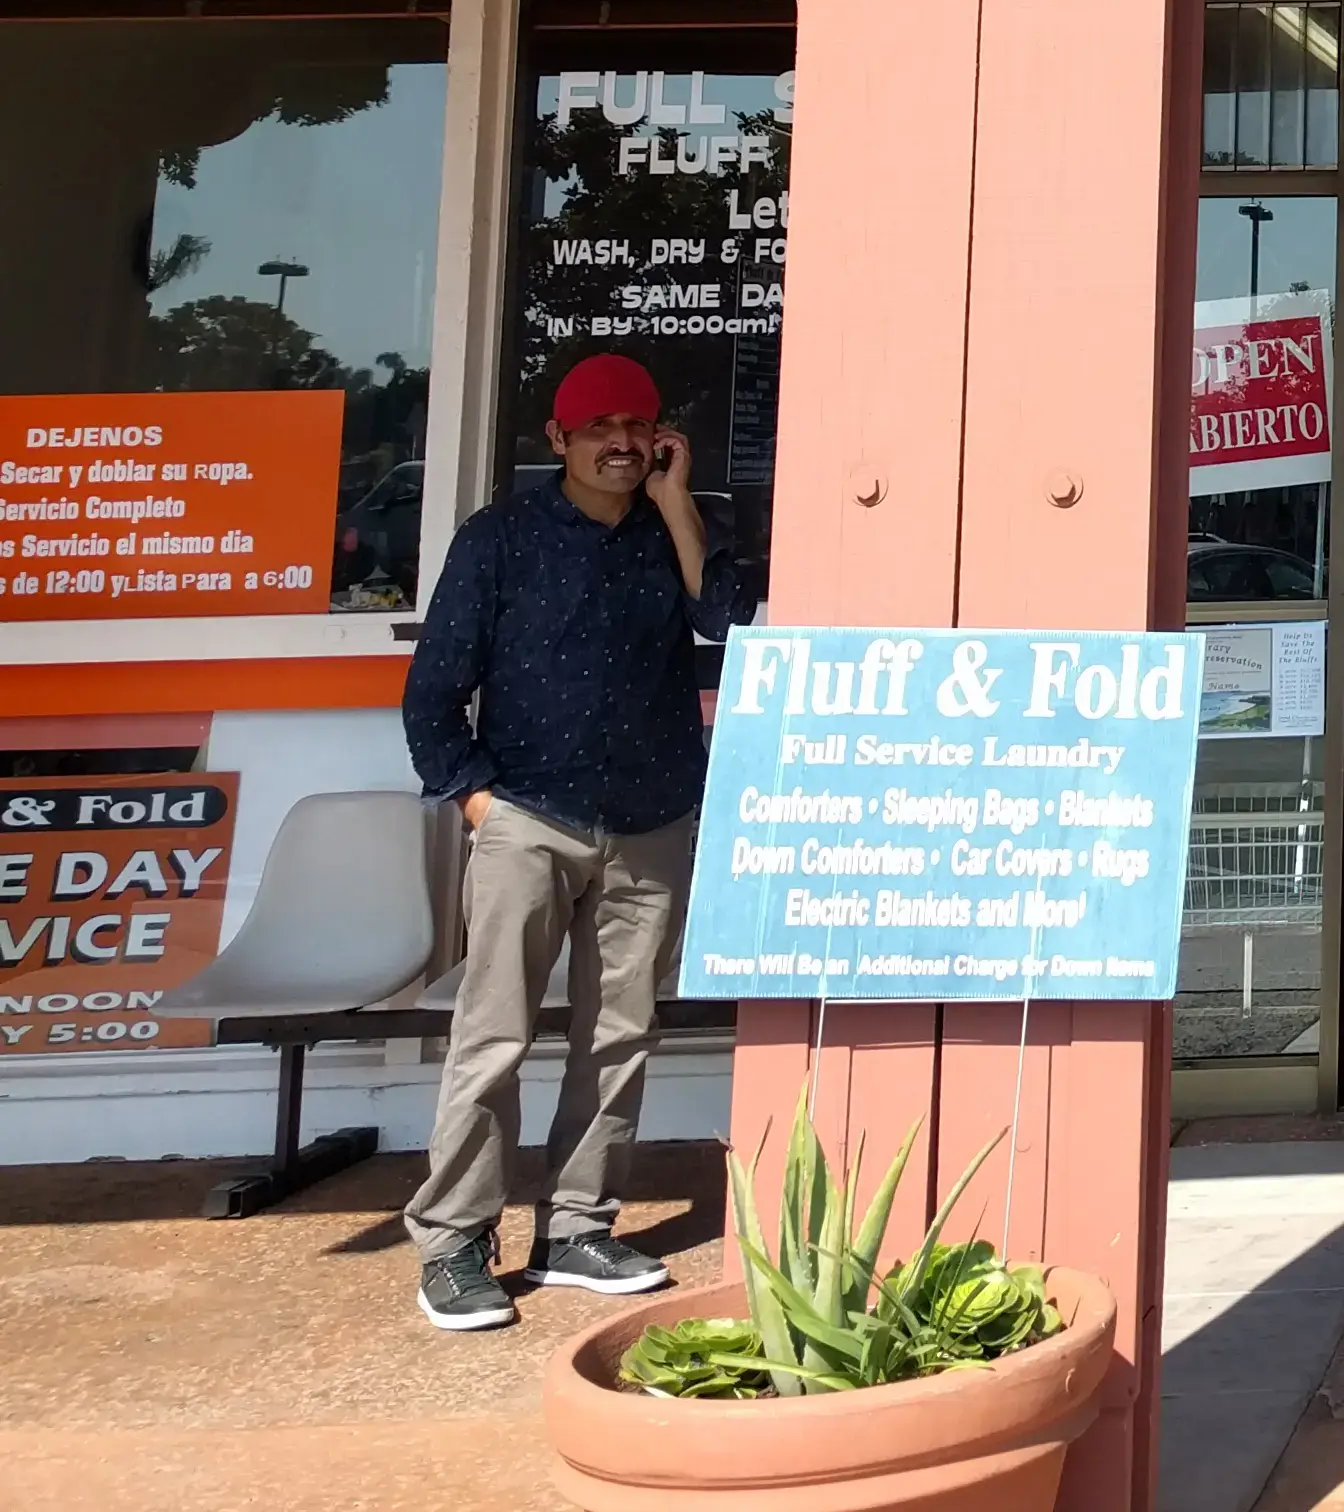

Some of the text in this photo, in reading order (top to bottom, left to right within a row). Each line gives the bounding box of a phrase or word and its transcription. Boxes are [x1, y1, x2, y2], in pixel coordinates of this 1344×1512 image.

[557, 70, 726, 125] FULL
[618, 135, 770, 175] FLUFF
[728, 188, 790, 230] Let
[552, 239, 637, 268] WASH,
[651, 238, 705, 264] DRY
[720, 238, 740, 264] &
[622, 283, 721, 309] SAME
[547, 317, 573, 337] IN
[591, 316, 633, 335] BY
[26, 425, 163, 449] DEJENOS
[0, 459, 253, 488] Secar y doblar su Ropa.
[85, 495, 185, 524] Completo
[21, 532, 110, 558] Servicio
[116, 532, 136, 555] el
[142, 531, 214, 555] mismo
[220, 529, 254, 553] dia
[12, 571, 39, 596] de
[45, 569, 105, 595] 12:00
[182, 571, 232, 590] Para
[244, 571, 258, 590] a
[263, 566, 312, 589] 6:00
[731, 638, 925, 717] Fluff
[936, 639, 1004, 719] &
[1022, 641, 1186, 721] Fold
[781, 734, 1126, 776] Full Service Laundry
[1, 791, 206, 826] & Fold
[739, 786, 1154, 835] Comforters Sleeping Bags Blankets
[51, 847, 223, 898] DAY
[731, 836, 1150, 887] Down Comforters Car Covers Rugs
[785, 888, 871, 927] Electric
[875, 889, 971, 927] Blankets
[976, 889, 1020, 927] and
[703, 953, 755, 976] There
[759, 953, 795, 975] Will
[797, 953, 823, 976] Be
[825, 957, 849, 976] an
[857, 954, 950, 976] Additional
[953, 954, 1018, 981] Charge
[1051, 954, 1103, 977] Down
[0, 990, 164, 1014] NOON
[1, 1021, 160, 1044] Y 5:00
